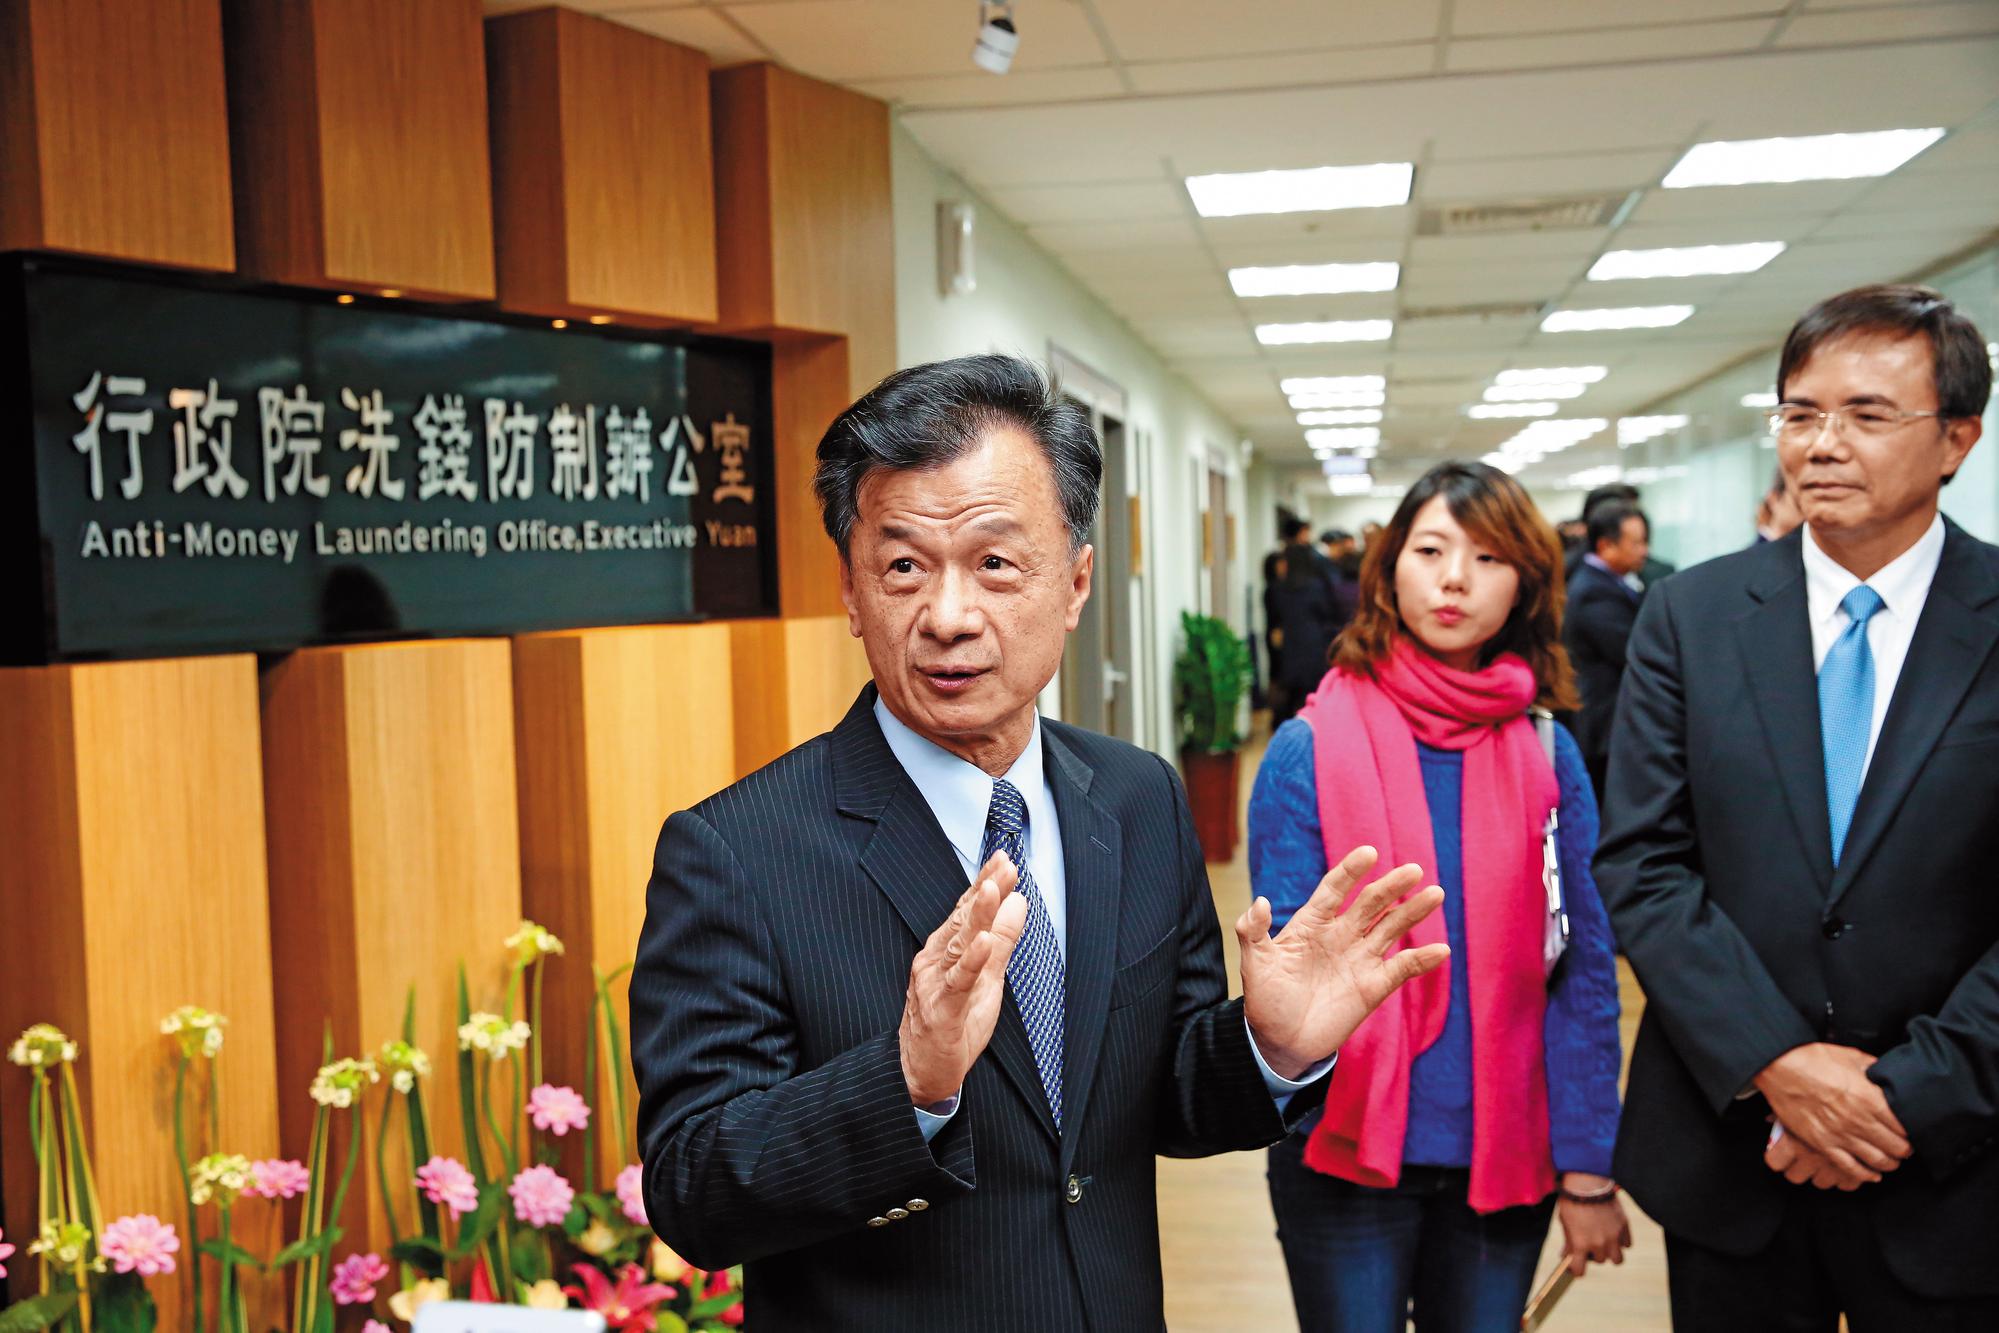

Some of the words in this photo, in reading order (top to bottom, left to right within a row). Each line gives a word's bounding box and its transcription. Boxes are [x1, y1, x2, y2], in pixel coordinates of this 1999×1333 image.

[73, 371, 755, 504] 行政院洗錢防制辦公室
[81, 520, 299, 564] Anti-Money
[315, 518, 487, 558] Laundering
[705, 519, 757, 548] Yuan
